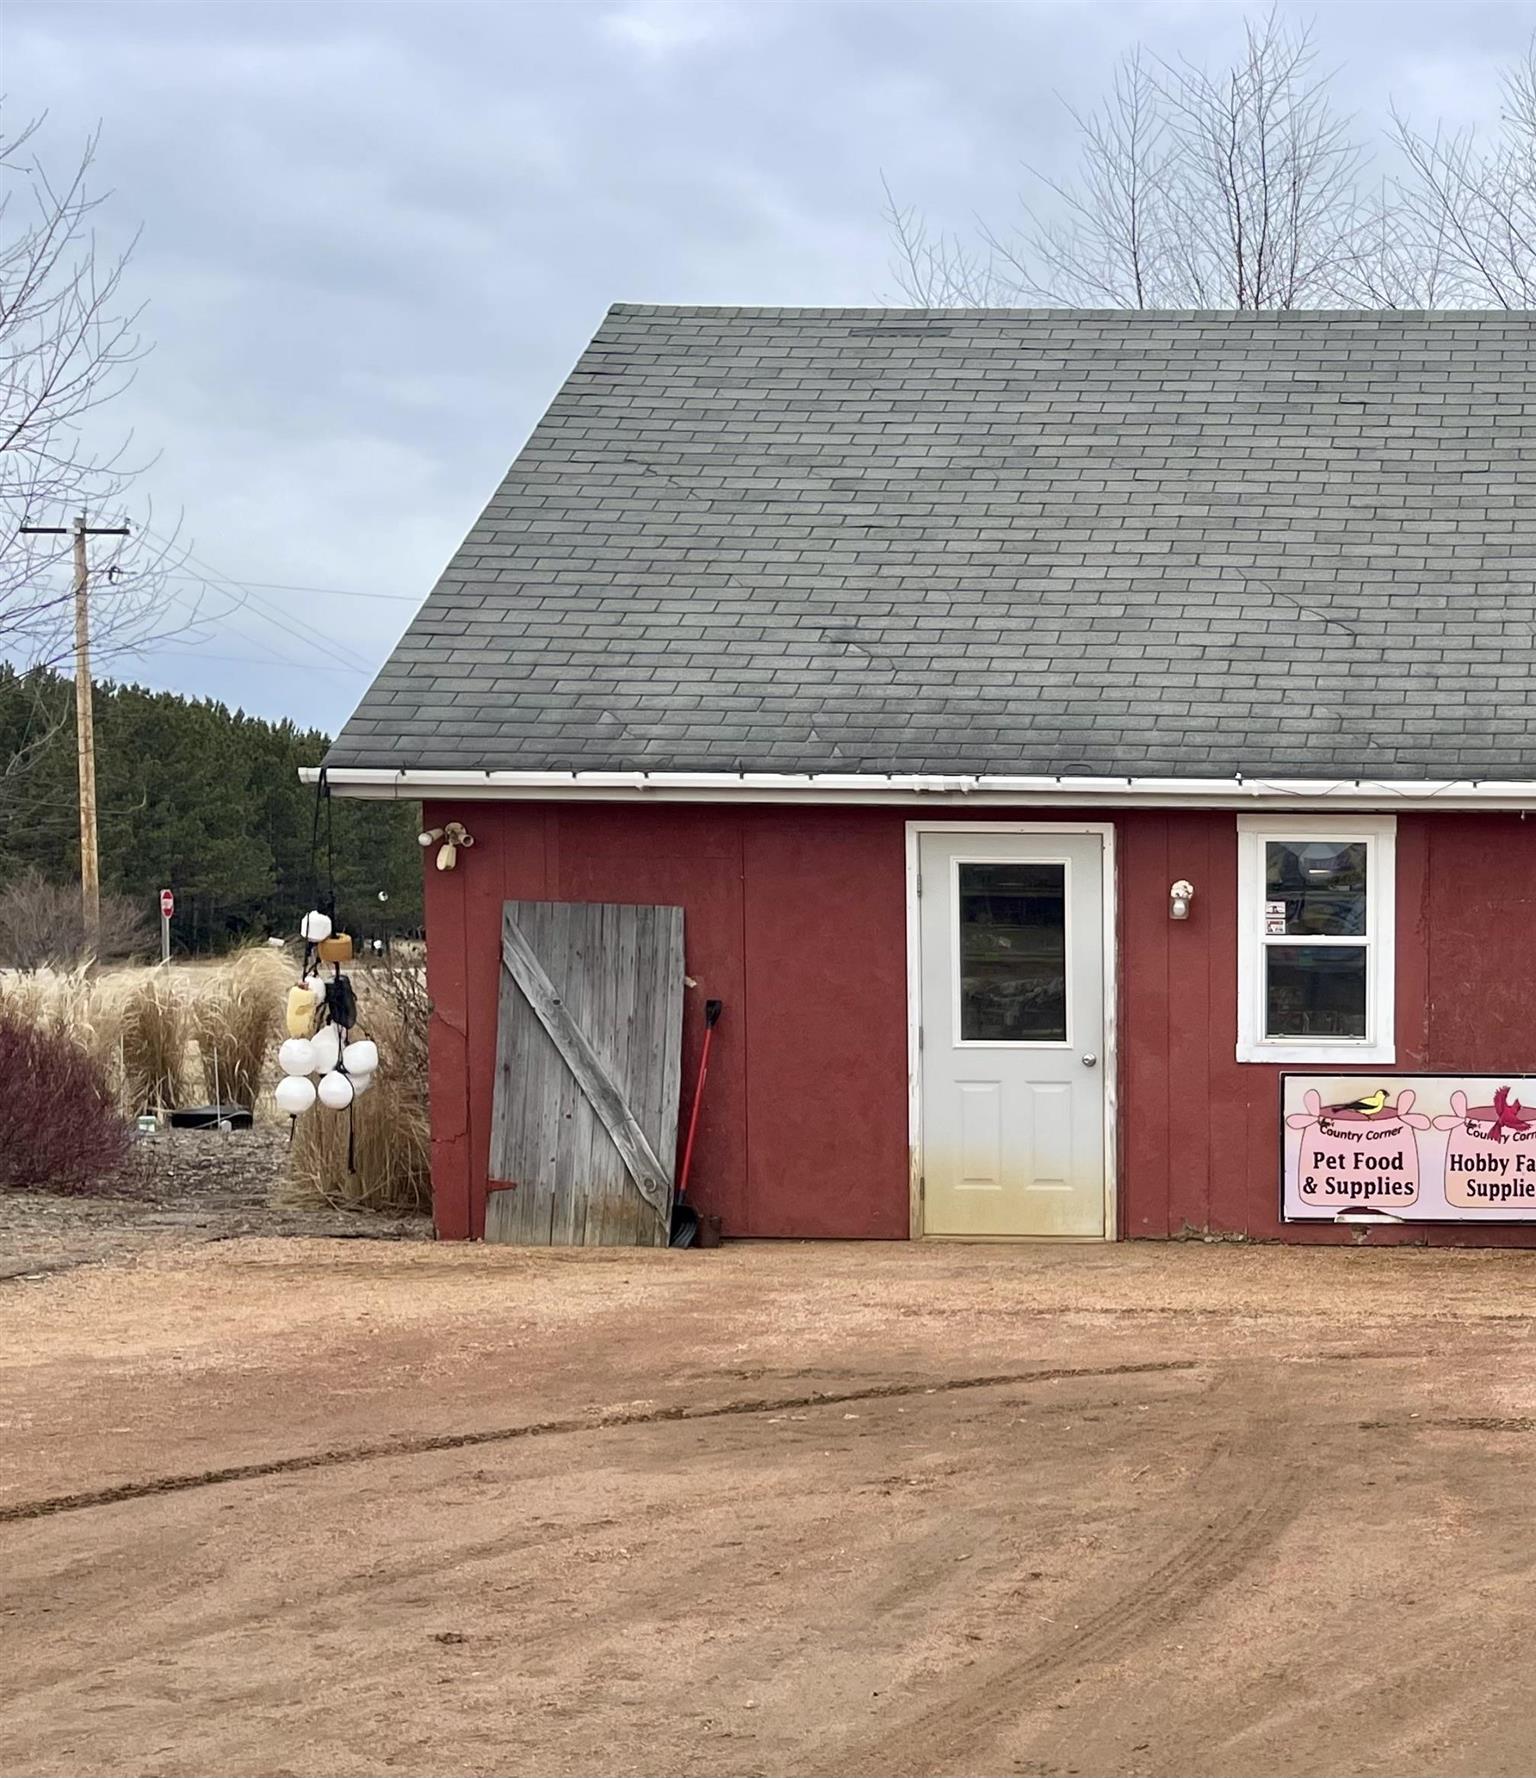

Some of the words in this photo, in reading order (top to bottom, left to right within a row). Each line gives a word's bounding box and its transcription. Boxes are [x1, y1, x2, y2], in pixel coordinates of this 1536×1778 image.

[1319, 1125, 1363, 1143] Country
[1366, 1126, 1404, 1141] Corner
[1466, 1126, 1510, 1145] Coury
[1313, 1152, 1346, 1170] Pet
[1353, 1151, 1404, 1170] Food
[1450, 1153, 1510, 1176] Hobby
[1303, 1176, 1318, 1195] &
[1325, 1176, 1414, 1199] Supplies
